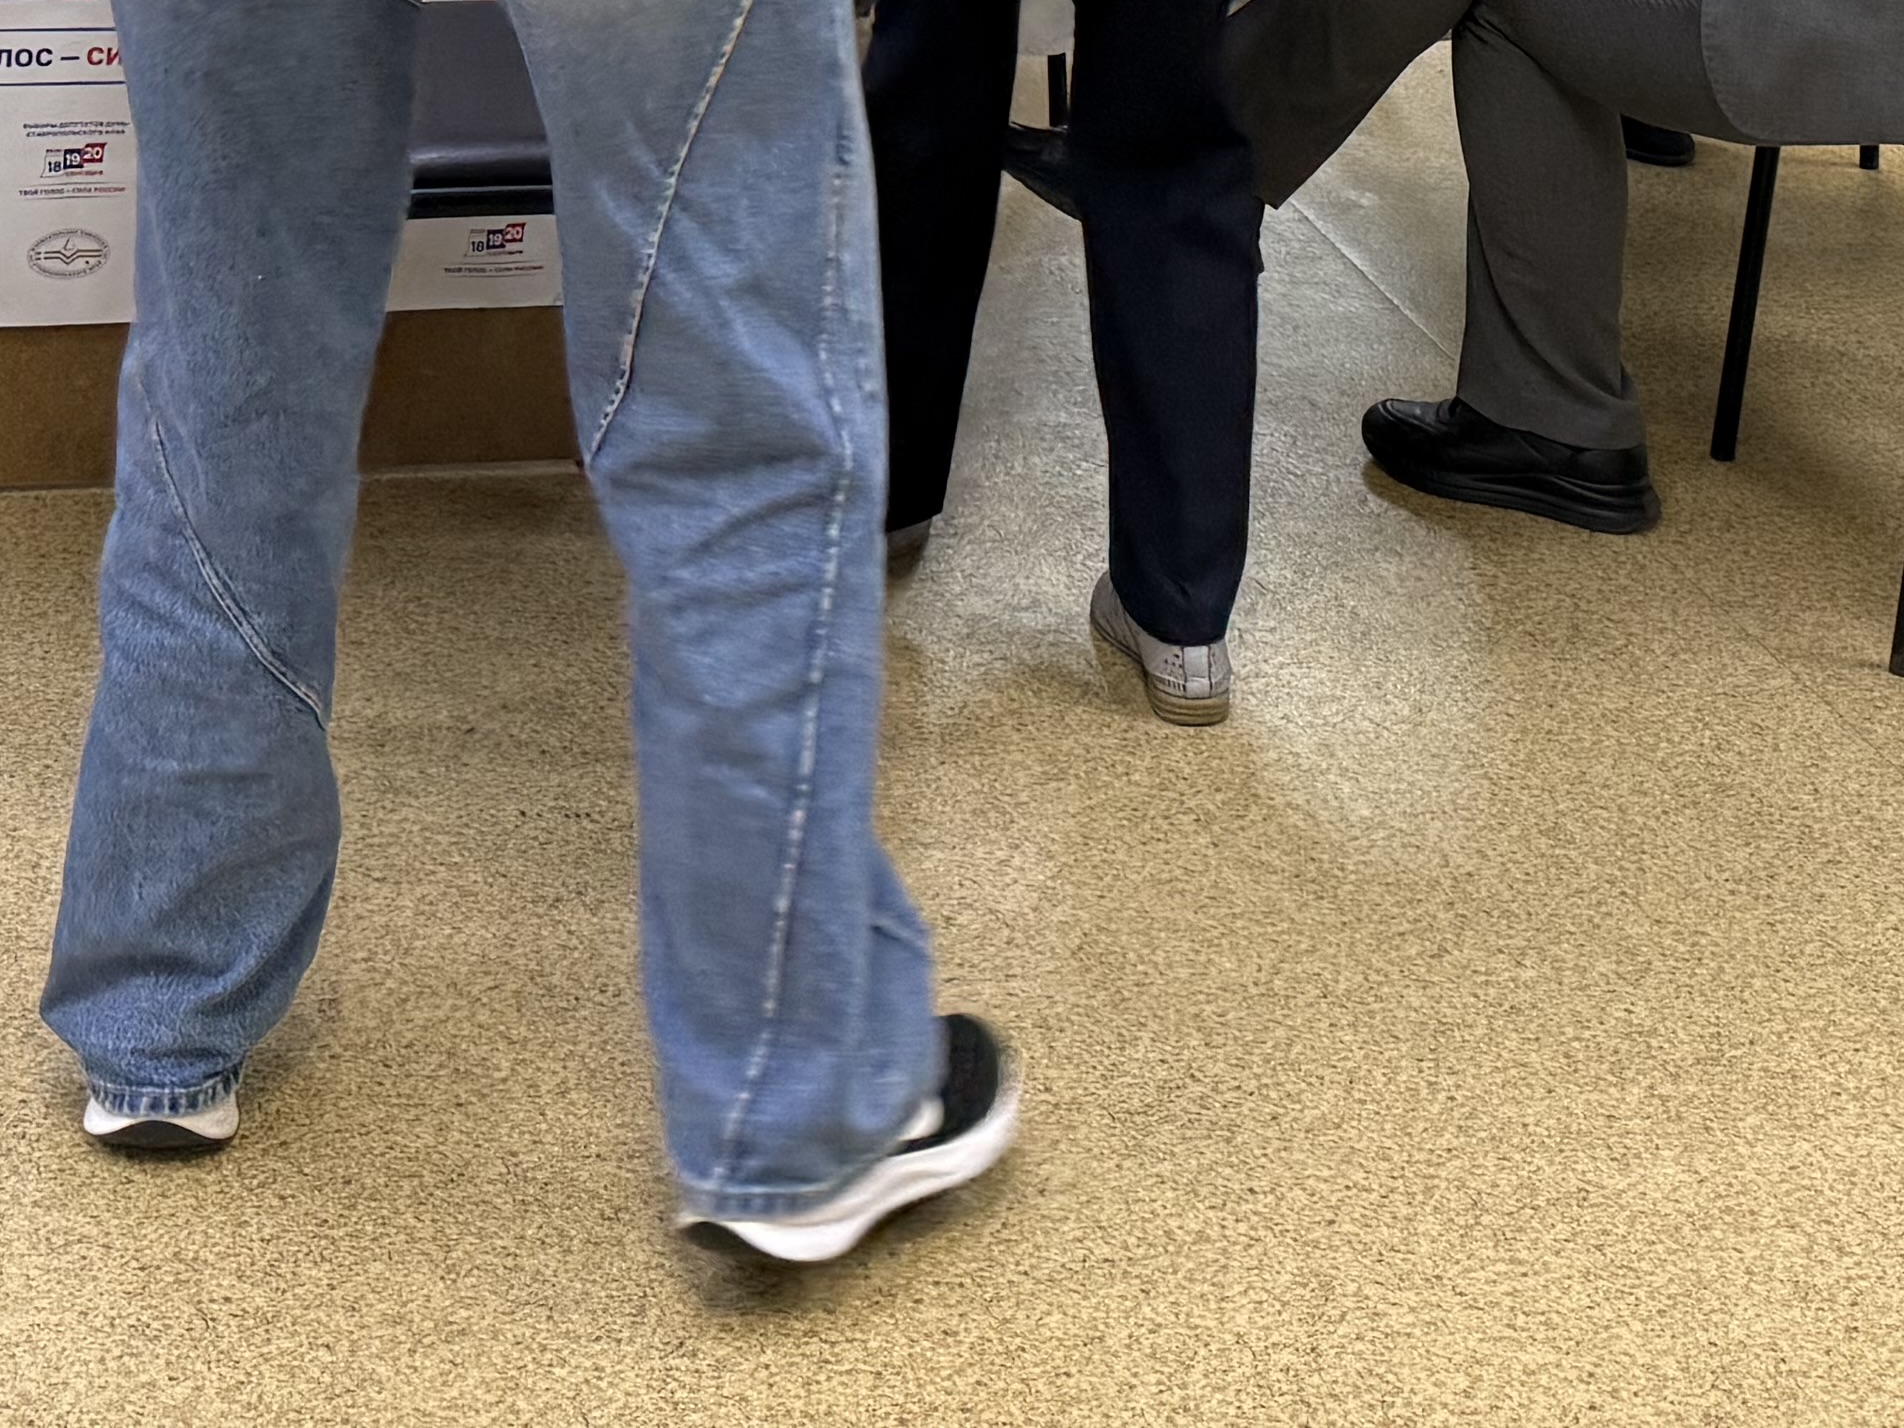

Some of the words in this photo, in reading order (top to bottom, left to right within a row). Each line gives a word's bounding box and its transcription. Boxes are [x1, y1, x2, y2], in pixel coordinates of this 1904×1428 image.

[86, 46, 121, 67] СИ
[47, 160, 61, 173] 18
[65, 153, 80, 166] 19
[83, 147, 102, 160] 20
[504, 227, 523, 240] 20
